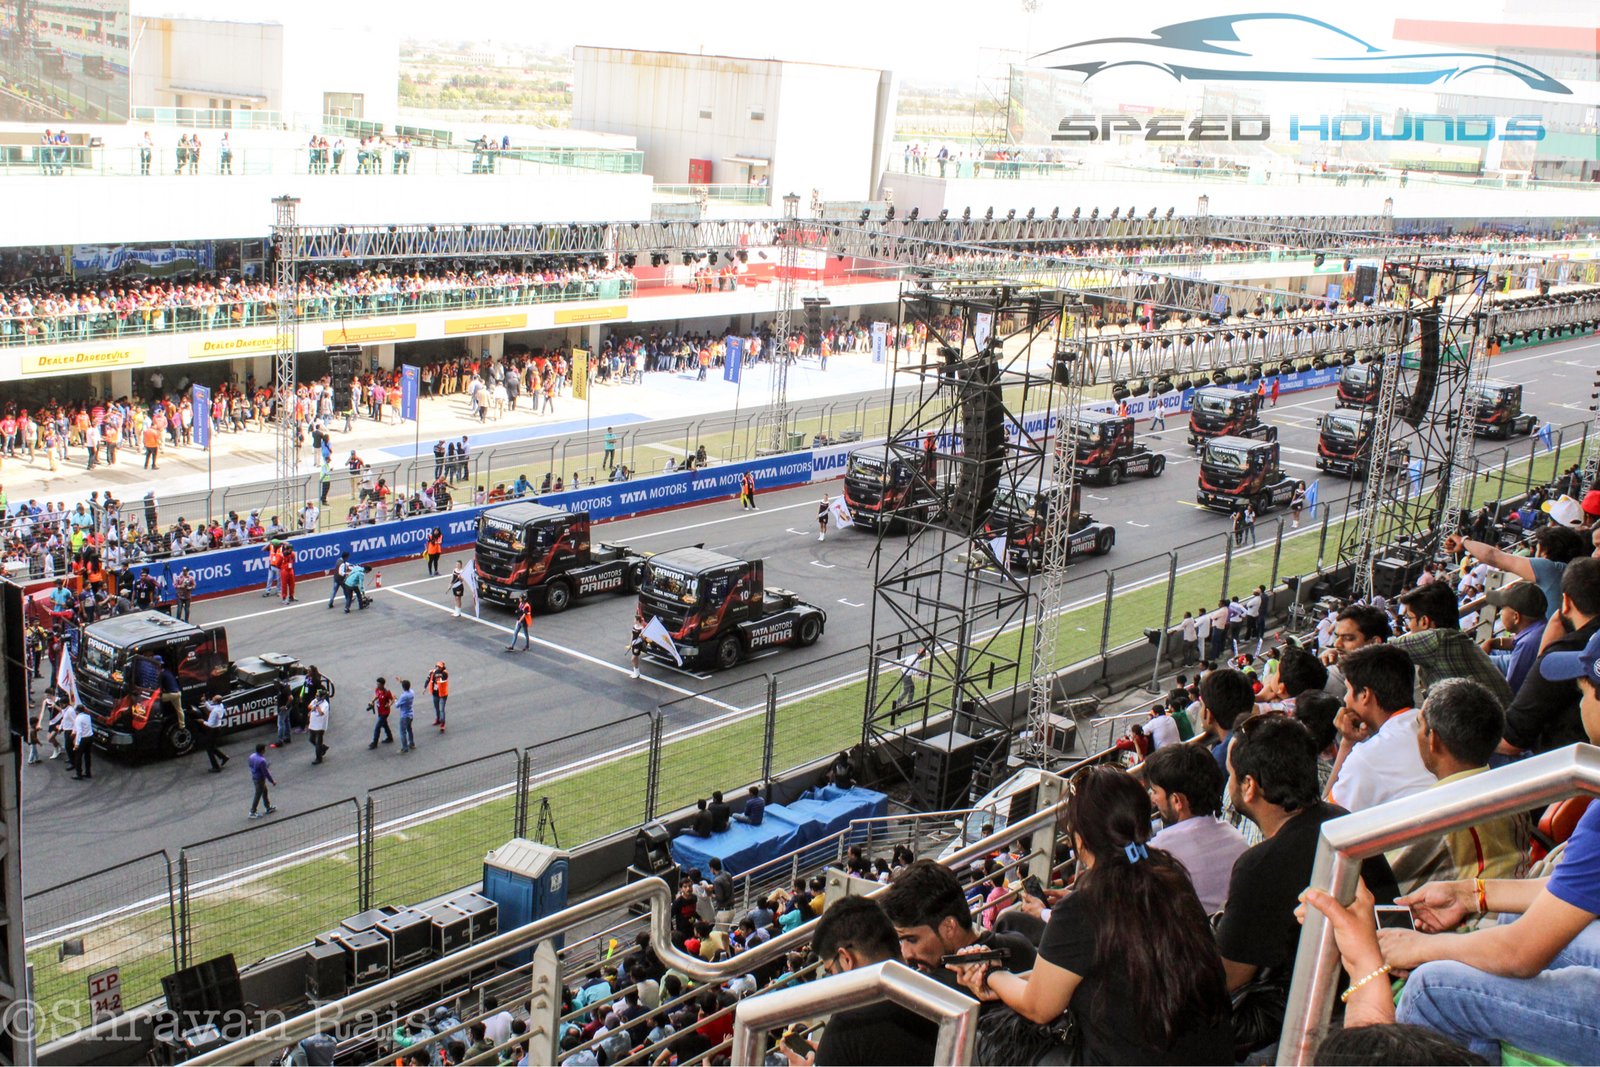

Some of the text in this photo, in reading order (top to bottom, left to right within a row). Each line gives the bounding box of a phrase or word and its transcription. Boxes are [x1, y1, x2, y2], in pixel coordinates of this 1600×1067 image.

[204, 341, 235, 351] DEALER
[38, 351, 130, 366] DEALER DAREDEVILS
[1025, 417, 1057, 434] WABC
[753, 461, 812, 480] TATA MOTORS
[692, 470, 754, 491] TATA MOTOS
[620, 482, 687, 505] TATA MOTORS
[571, 496, 612, 512] MOTORS
[488, 519, 513, 531] PRIMA
[351, 528, 434, 553] TATA MOTOR
[515, 529, 521, 540] 7
[570, 539, 576, 549] 7
[1070, 540, 1095, 554] PRIMA
[243, 543, 341, 573] TAT OTORS
[580, 569, 622, 585] TATA MOTORS
[655, 567, 684, 582] PRIMA
[579, 577, 622, 594] PRIMA
[686, 578, 698, 590] 10
[739, 590, 749, 602] 10
[751, 620, 793, 637] TATA MOTORS
[88, 637, 115, 656] PRIMA
[751, 628, 793, 648] PRIMA
[223, 695, 278, 717] ATA MOTORS
[220, 705, 278, 728] PRIMA
[91, 973, 118, 997] IP
